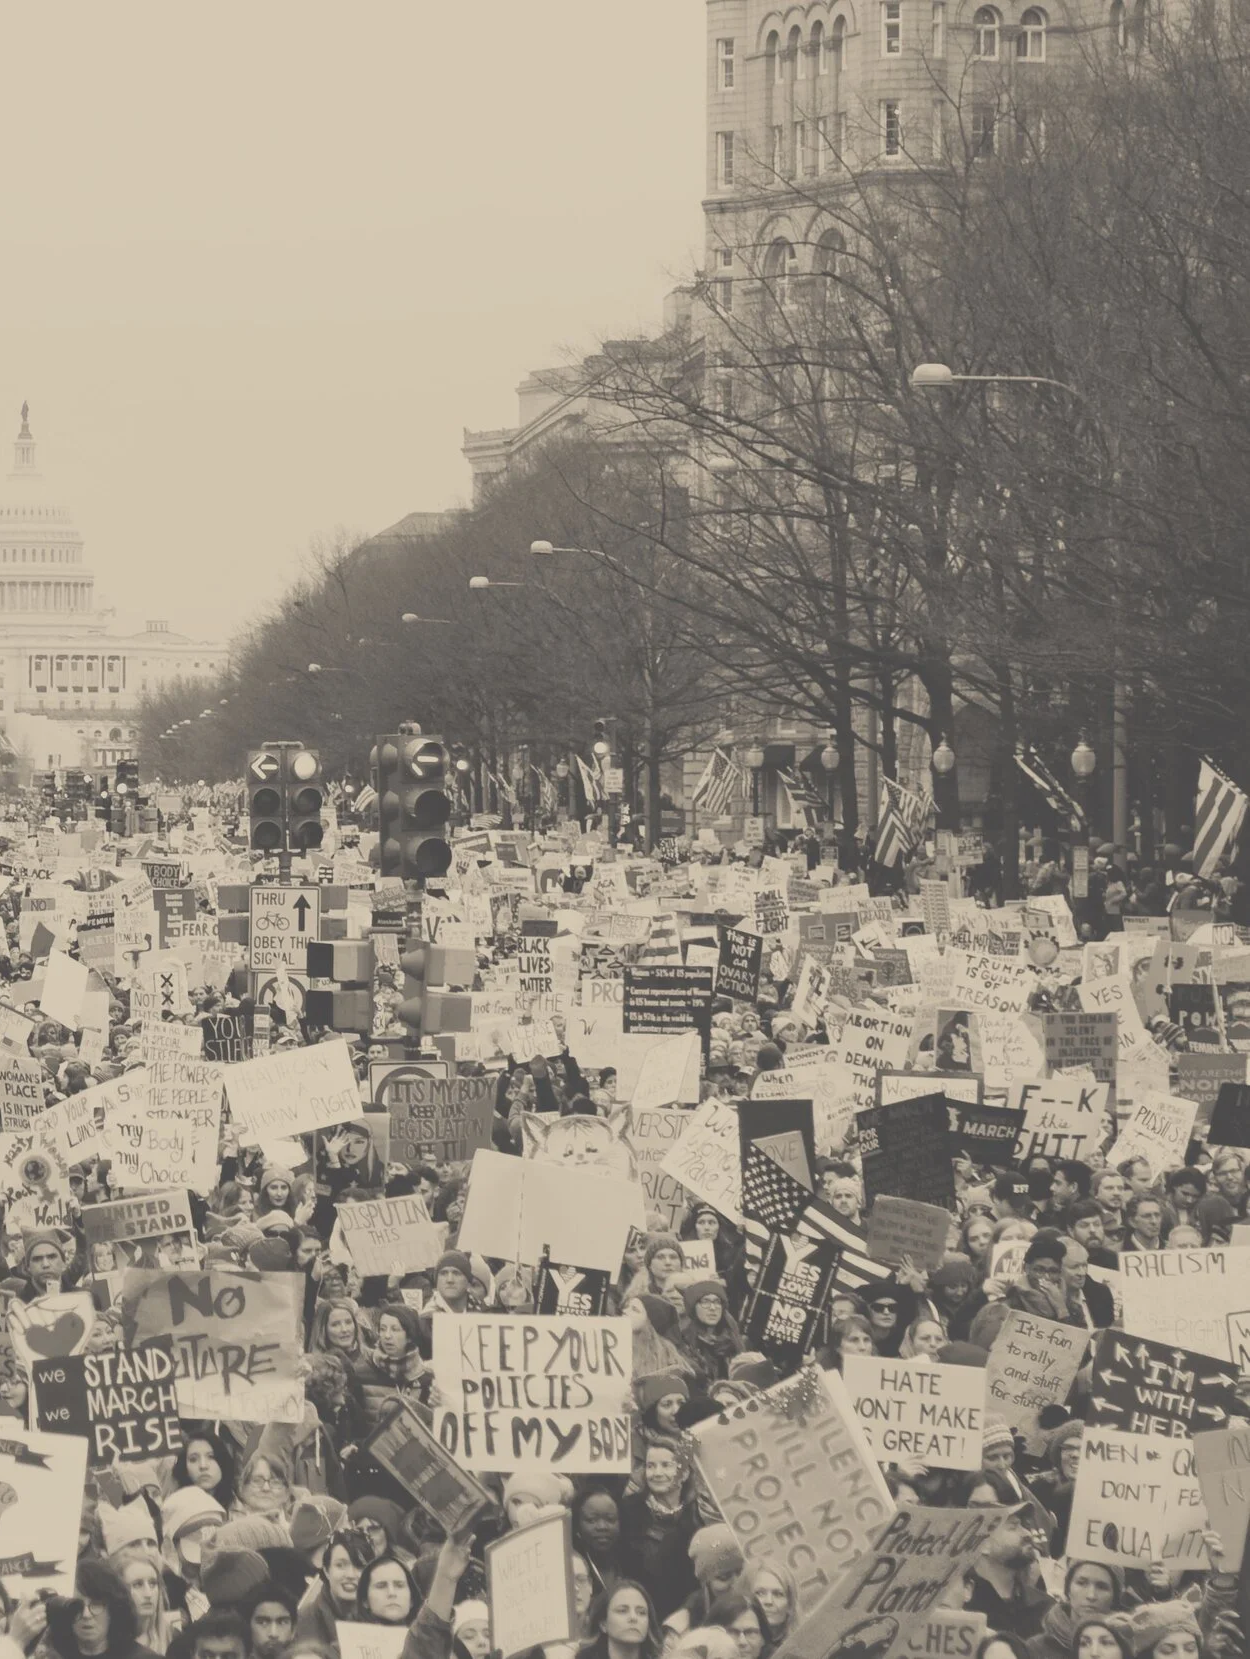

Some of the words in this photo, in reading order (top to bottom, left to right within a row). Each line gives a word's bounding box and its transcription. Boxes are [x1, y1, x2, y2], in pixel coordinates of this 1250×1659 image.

[19, 866, 53, 881] BLACK
[255, 892, 286, 906] THRU
[182, 923, 209, 937] FEAR
[755, 916, 790, 932] FIGHT
[253, 936, 284, 949] OBEY
[517, 937, 550, 955] BLACK
[727, 929, 745, 945] this
[747, 935, 757, 948] is
[1213, 926, 1234, 945] NO!
[729, 945, 755, 960] NOT
[733, 958, 749, 969] an
[518, 957, 551, 974] LIVES
[719, 963, 756, 983] OVARY
[966, 954, 1025, 977] TRUMP
[519, 977, 553, 993] MATTER
[717, 976, 754, 998] ACTION
[966, 967, 979, 979] IS
[980, 970, 1028, 988] GUILTY
[984, 981, 1001, 991] OF
[134, 993, 156, 1008] NOT
[956, 985, 1022, 1013] TREASON
[1090, 984, 1123, 1006] YES
[473, 1003, 491, 1015] not
[494, 1002, 515, 1016] free
[847, 1013, 913, 1039] ABORTION
[865, 1036, 885, 1051] ON
[845, 1052, 893, 1071] DEMAND
[146, 1062, 171, 1084] THE
[173, 1063, 210, 1085] POWER
[4, 1083, 38, 1099] PLACE
[146, 1087, 168, 1106] THE
[171, 1088, 210, 1106] PEOPLE
[391, 1078, 424, 1101] IT'S
[431, 1078, 459, 1101] MY
[459, 1076, 495, 1101] BODY
[3, 1102, 13, 1115] IS
[13, 1103, 23, 1116] IN
[26, 1104, 45, 1118] THE
[310, 1088, 358, 1121] RIGHT
[440, 1103, 466, 1118] YOUR
[390, 1118, 483, 1141] LEGISLATION
[962, 1120, 1018, 1141] MARCH
[1034, 1111, 1073, 1130] this
[117, 1121, 144, 1147] my
[146, 1128, 184, 1163] Body
[859, 1127, 880, 1142] FOR
[34, 1199, 73, 1227] World
[103, 1199, 171, 1220] UNITED
[338, 1202, 430, 1233] DISPUTIN
[125, 1213, 187, 1235] STAND
[368, 1227, 402, 1246] THIS
[779, 1232, 822, 1282] YES
[1123, 1251, 1228, 1279] RACISM
[778, 1277, 816, 1299] LOVE
[167, 1274, 246, 1327] NO
[770, 1299, 808, 1324] NO
[1014, 1318, 1044, 1340] It's
[1046, 1328, 1073, 1350] fun
[458, 1323, 539, 1374] KEEP
[543, 1325, 625, 1378] YOUR
[1005, 1340, 1022, 1358] to
[38, 1367, 66, 1385] we
[83, 1347, 173, 1388] STAND
[1144, 1360, 1196, 1392] I'M
[880, 1368, 942, 1397] HATE
[1004, 1365, 1029, 1384] and
[1029, 1372, 1064, 1394] stuff
[462, 1372, 594, 1412] POLICIES
[989, 1380, 1011, 1402] for
[1134, 1385, 1196, 1419] WITH
[86, 1383, 179, 1422] MARCH
[919, 1402, 981, 1432] MAKE
[1130, 1411, 1188, 1439] HER
[45, 1406, 71, 1422] we
[94, 1416, 184, 1458] RISE
[440, 1410, 500, 1458] OFF
[510, 1415, 583, 1464] MY
[587, 1413, 631, 1464] BODY
[882, 1429, 966, 1460] GREAT!
[1085, 1439, 1140, 1466] MEN
[1100, 1479, 1161, 1503] DON'T
[730, 1427, 830, 1593] PROTECT
[842, 1555, 951, 1615] Planet
